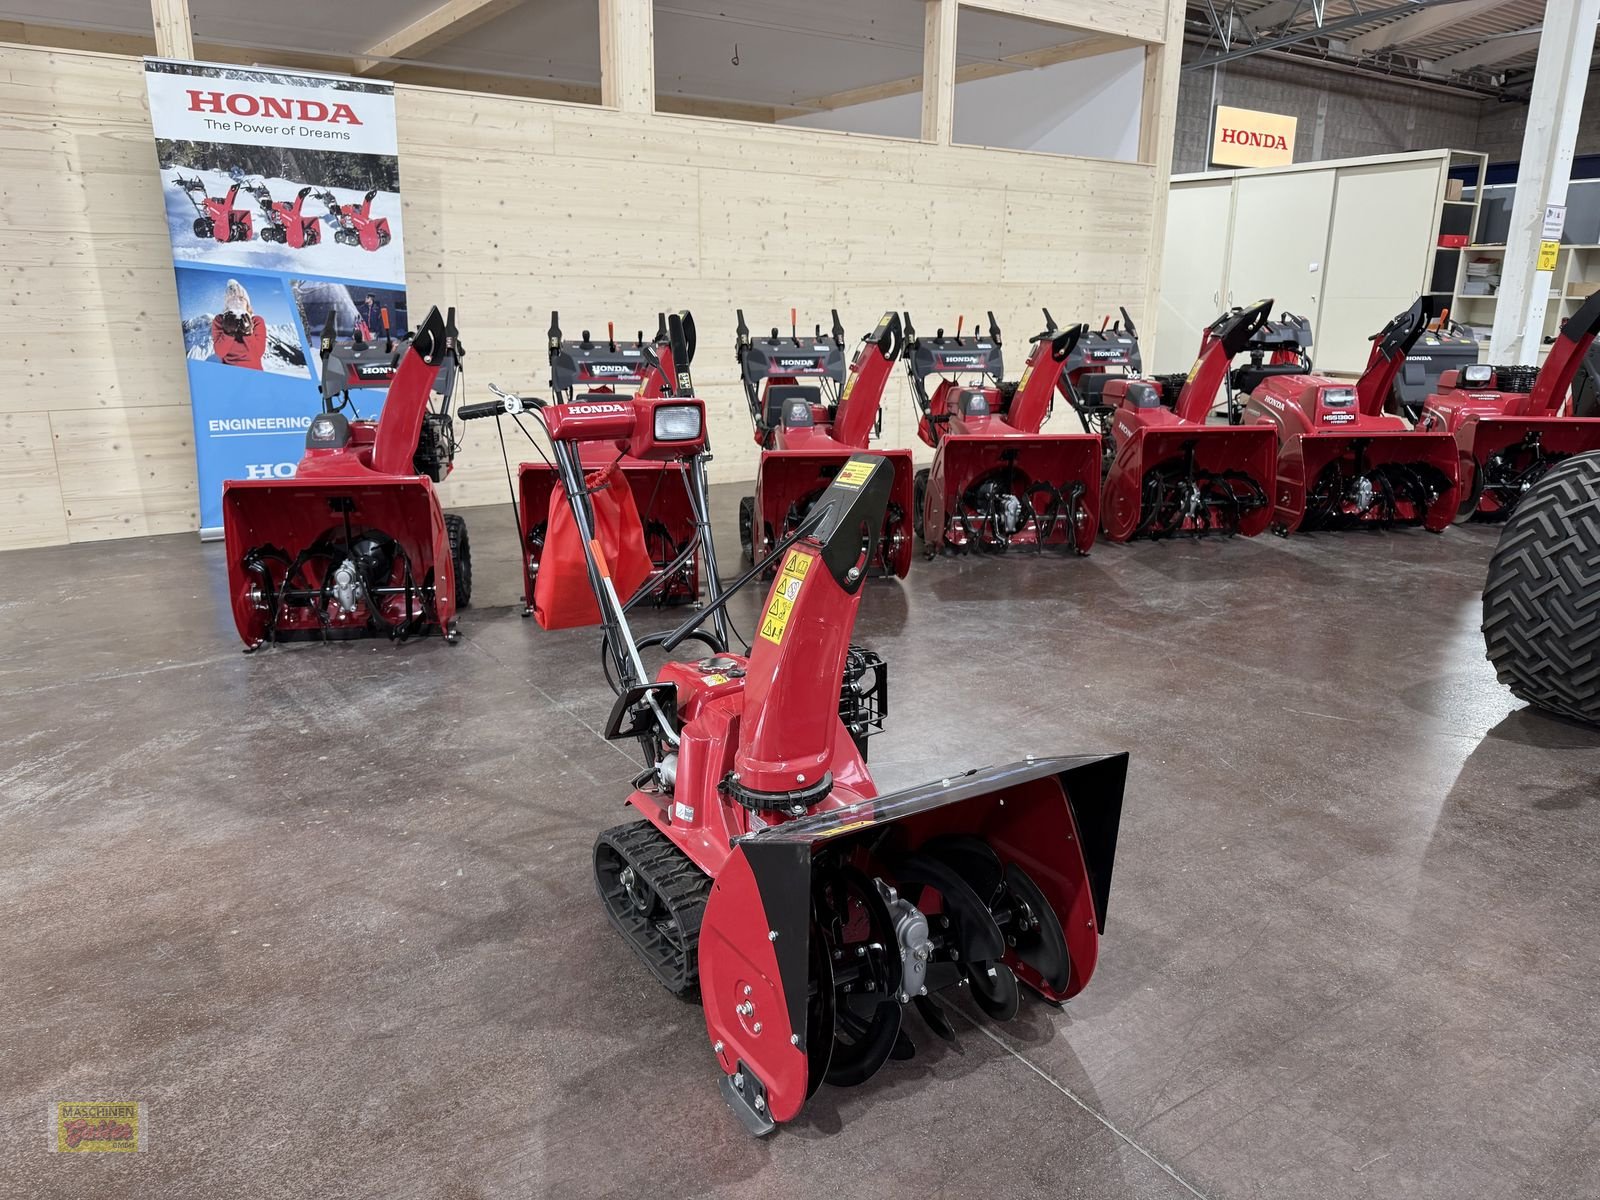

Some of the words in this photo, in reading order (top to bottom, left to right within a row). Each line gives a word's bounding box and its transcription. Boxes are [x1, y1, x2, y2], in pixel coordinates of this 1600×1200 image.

[186, 89, 363, 126] HONDA
[204, 119, 231, 131] The
[234, 121, 278, 135] Power
[281, 125, 296, 136] of
[299, 127, 351, 141] Dreams
[1221, 128, 1288, 150] HONDA
[592, 365, 630, 373] HONDA
[781, 359, 815, 367] HONDA
[568, 404, 625, 415] HONDA
[1264, 394, 1286, 412] HONDA
[208, 416, 311, 432] ENGINEERING
[245, 462, 298, 480] HO
